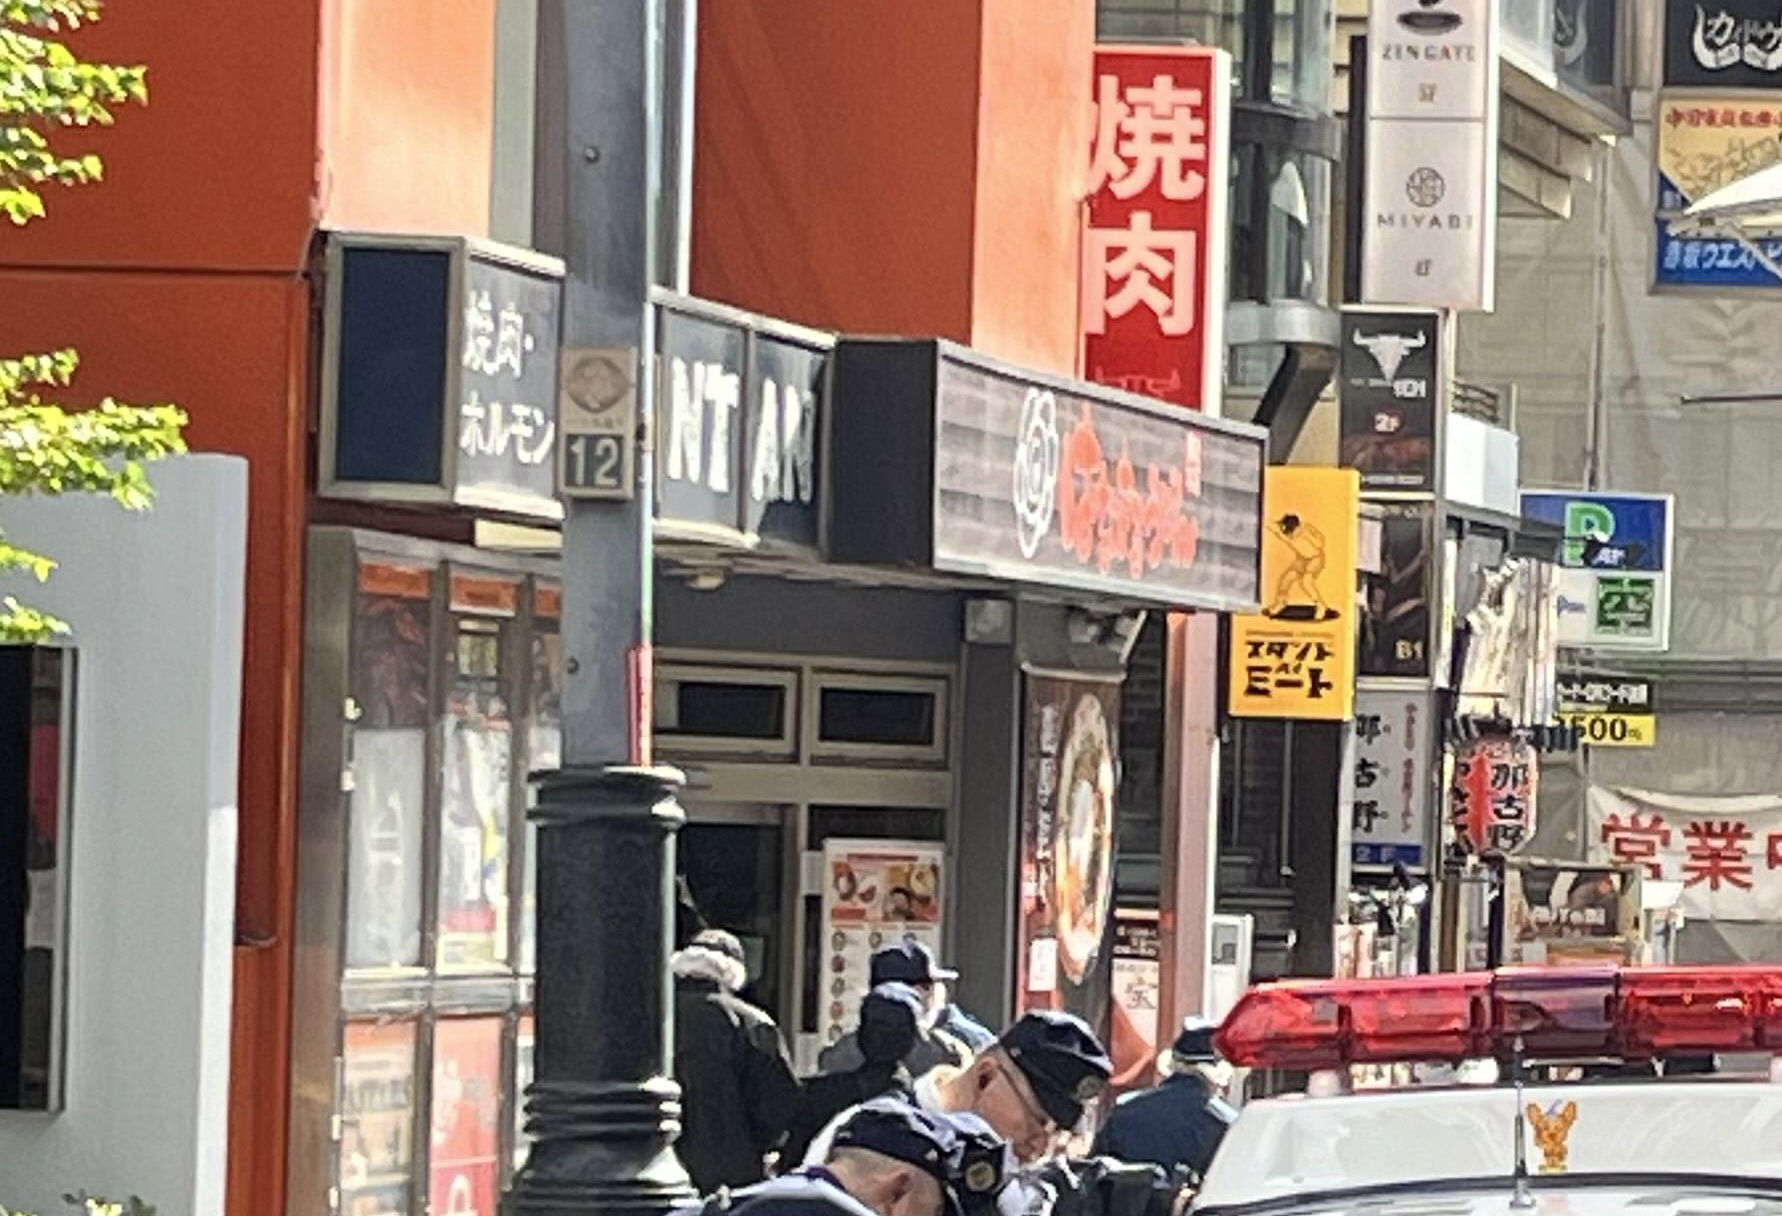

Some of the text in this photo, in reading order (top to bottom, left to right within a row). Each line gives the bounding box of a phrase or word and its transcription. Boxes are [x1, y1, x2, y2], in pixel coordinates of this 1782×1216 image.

[1382, 43, 1476, 62] ZENGATE
[1085, 73, 1206, 337] 焼肉
[1377, 213, 1473, 231] MIYABI
[459, 390, 555, 464] ホルモン
[569, 436, 619, 487] 12
[1395, 639, 1424, 660] B1
